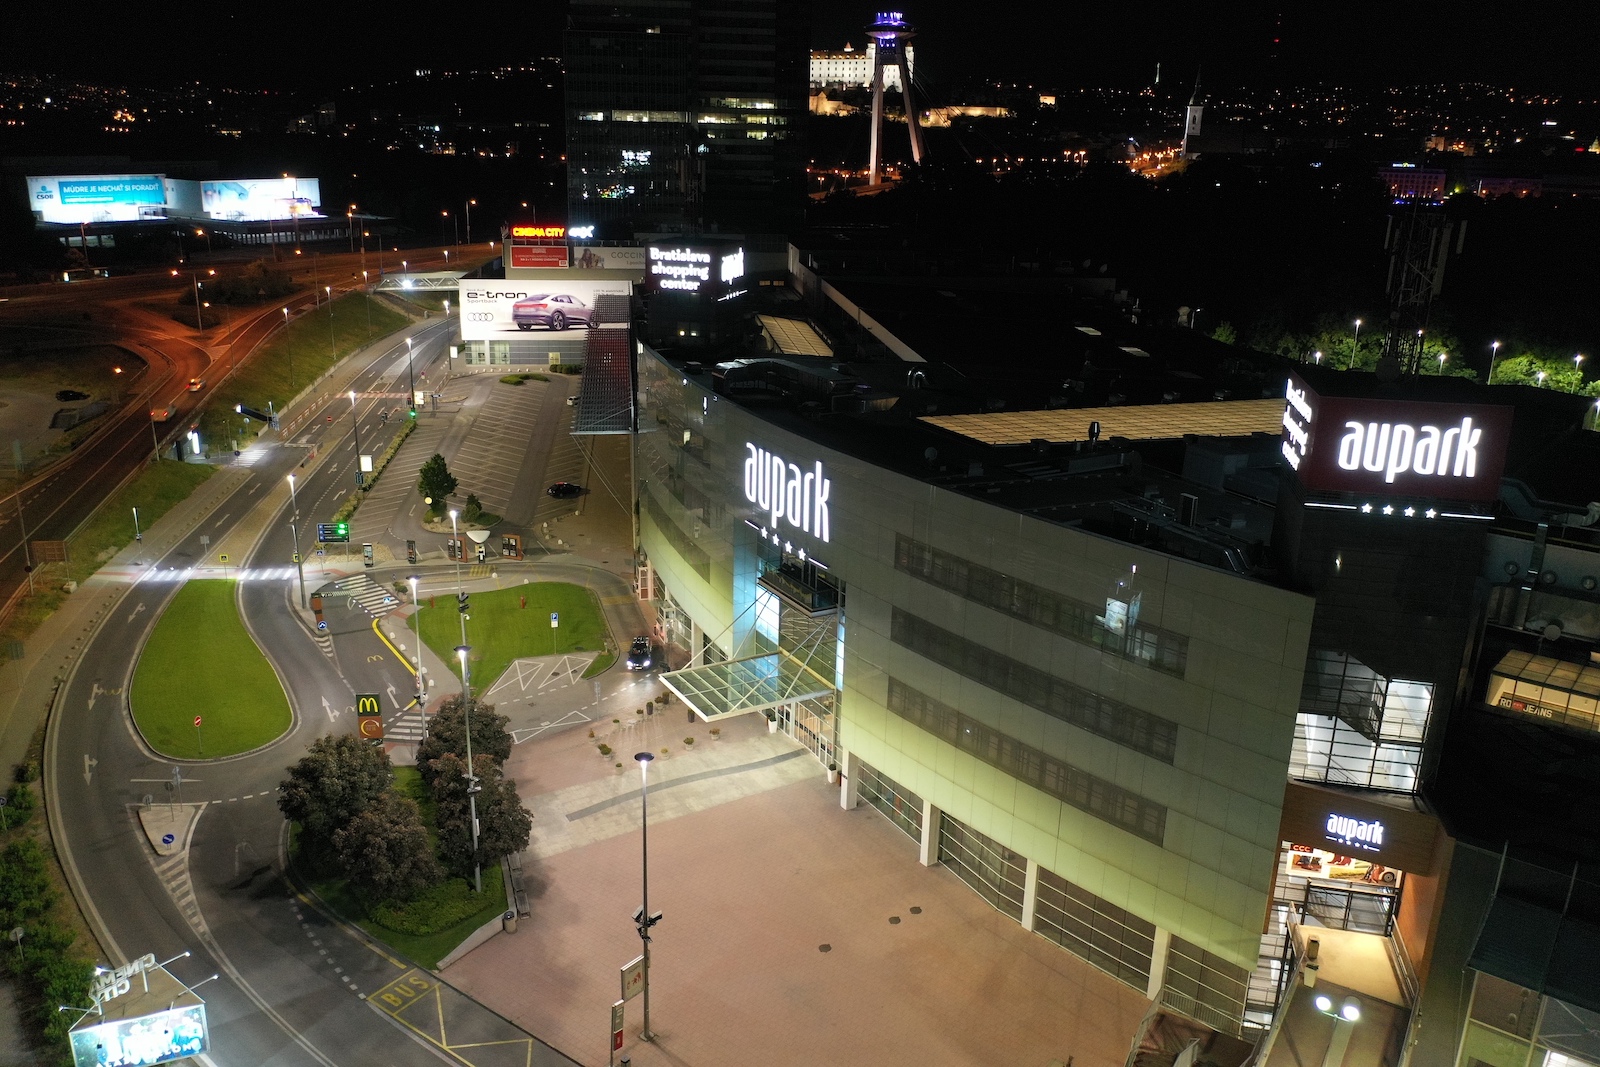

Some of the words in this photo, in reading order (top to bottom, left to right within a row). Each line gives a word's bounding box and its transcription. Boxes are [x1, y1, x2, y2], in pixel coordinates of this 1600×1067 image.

[90, 185, 97, 193] JE
[545, 227, 565, 237] CITY
[649, 246, 711, 263] Bratislava
[651, 261, 709, 280] shopping
[660, 279, 700, 291] center
[466, 290, 528, 299] e-tron
[1337, 416, 1483, 484] aupark
[744, 441, 831, 544] aupark
[1522, 704, 1553, 719] JEANS
[1325, 812, 1385, 845] aupark
[380, 976, 429, 1007] BUS
